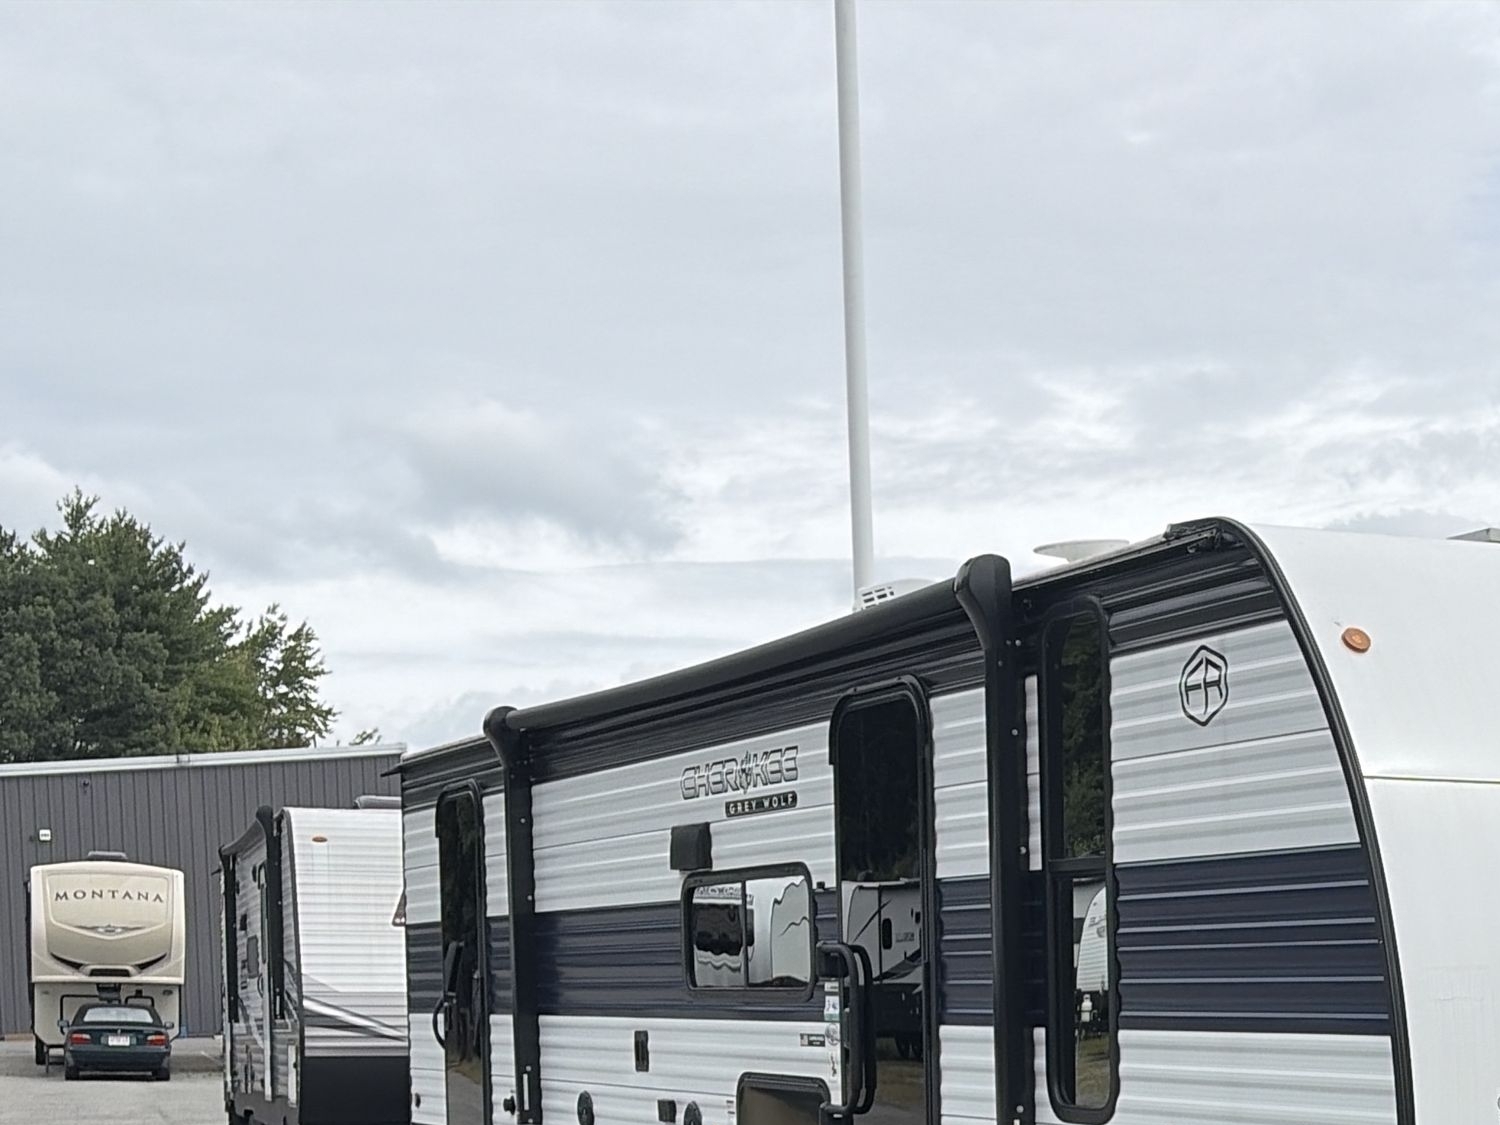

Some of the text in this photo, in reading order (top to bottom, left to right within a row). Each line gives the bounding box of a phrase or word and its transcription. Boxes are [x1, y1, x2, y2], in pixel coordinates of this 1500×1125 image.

[729, 793, 794, 815] GREY WOLF
[55, 889, 164, 903] MONTANA
